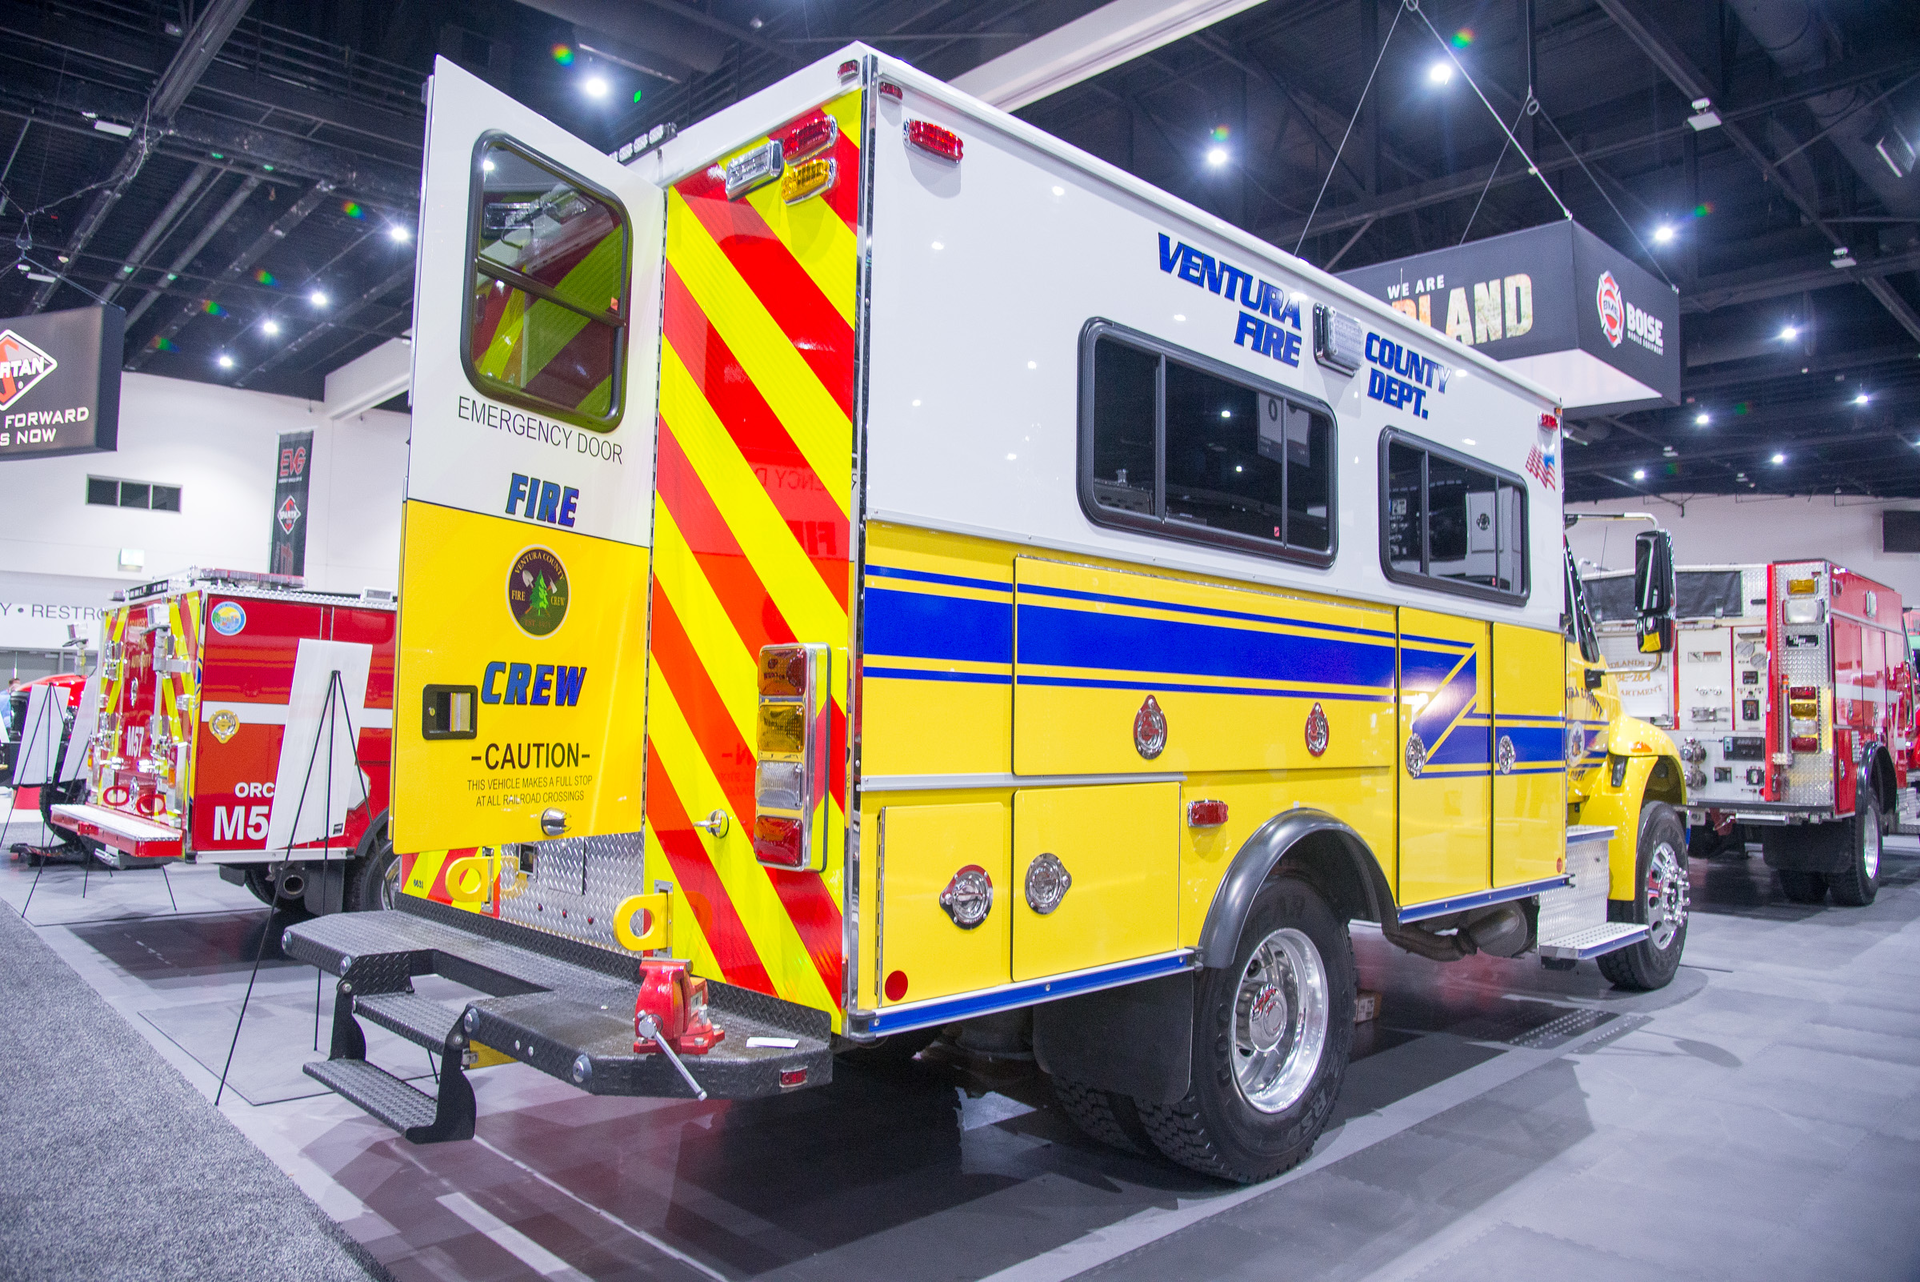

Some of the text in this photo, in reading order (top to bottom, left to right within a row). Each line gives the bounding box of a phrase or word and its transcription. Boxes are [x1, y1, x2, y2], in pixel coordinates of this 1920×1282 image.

[1387, 274, 1445, 300] WE ARE
[1158, 232, 1452, 393] VENTURA COUNTY
[1626, 301, 1664, 347] BOISE
[1234, 310, 1429, 420] FIRE DEPT.
[4, 406, 90, 429] FORWARD
[458, 395, 623, 465] EMERGENCY DOOR
[16, 428, 57, 445] NOW
[505, 472, 580, 528] FIRE
[514, 551, 565, 581] VENTURA COUNTY
[31, 603, 102, 621] RESTR
[511, 590, 565, 606] FIRE CREW
[481, 661, 588, 707] CREW
[126, 725, 145, 758] M57
[234, 781, 275, 798] ORC
[467, 775, 593, 791] THIS VEHICLE MAKES A FULL STOP
[476, 790, 585, 808] AT ALL RAILROAD CROSSINGS
[213, 805, 270, 841] M5
